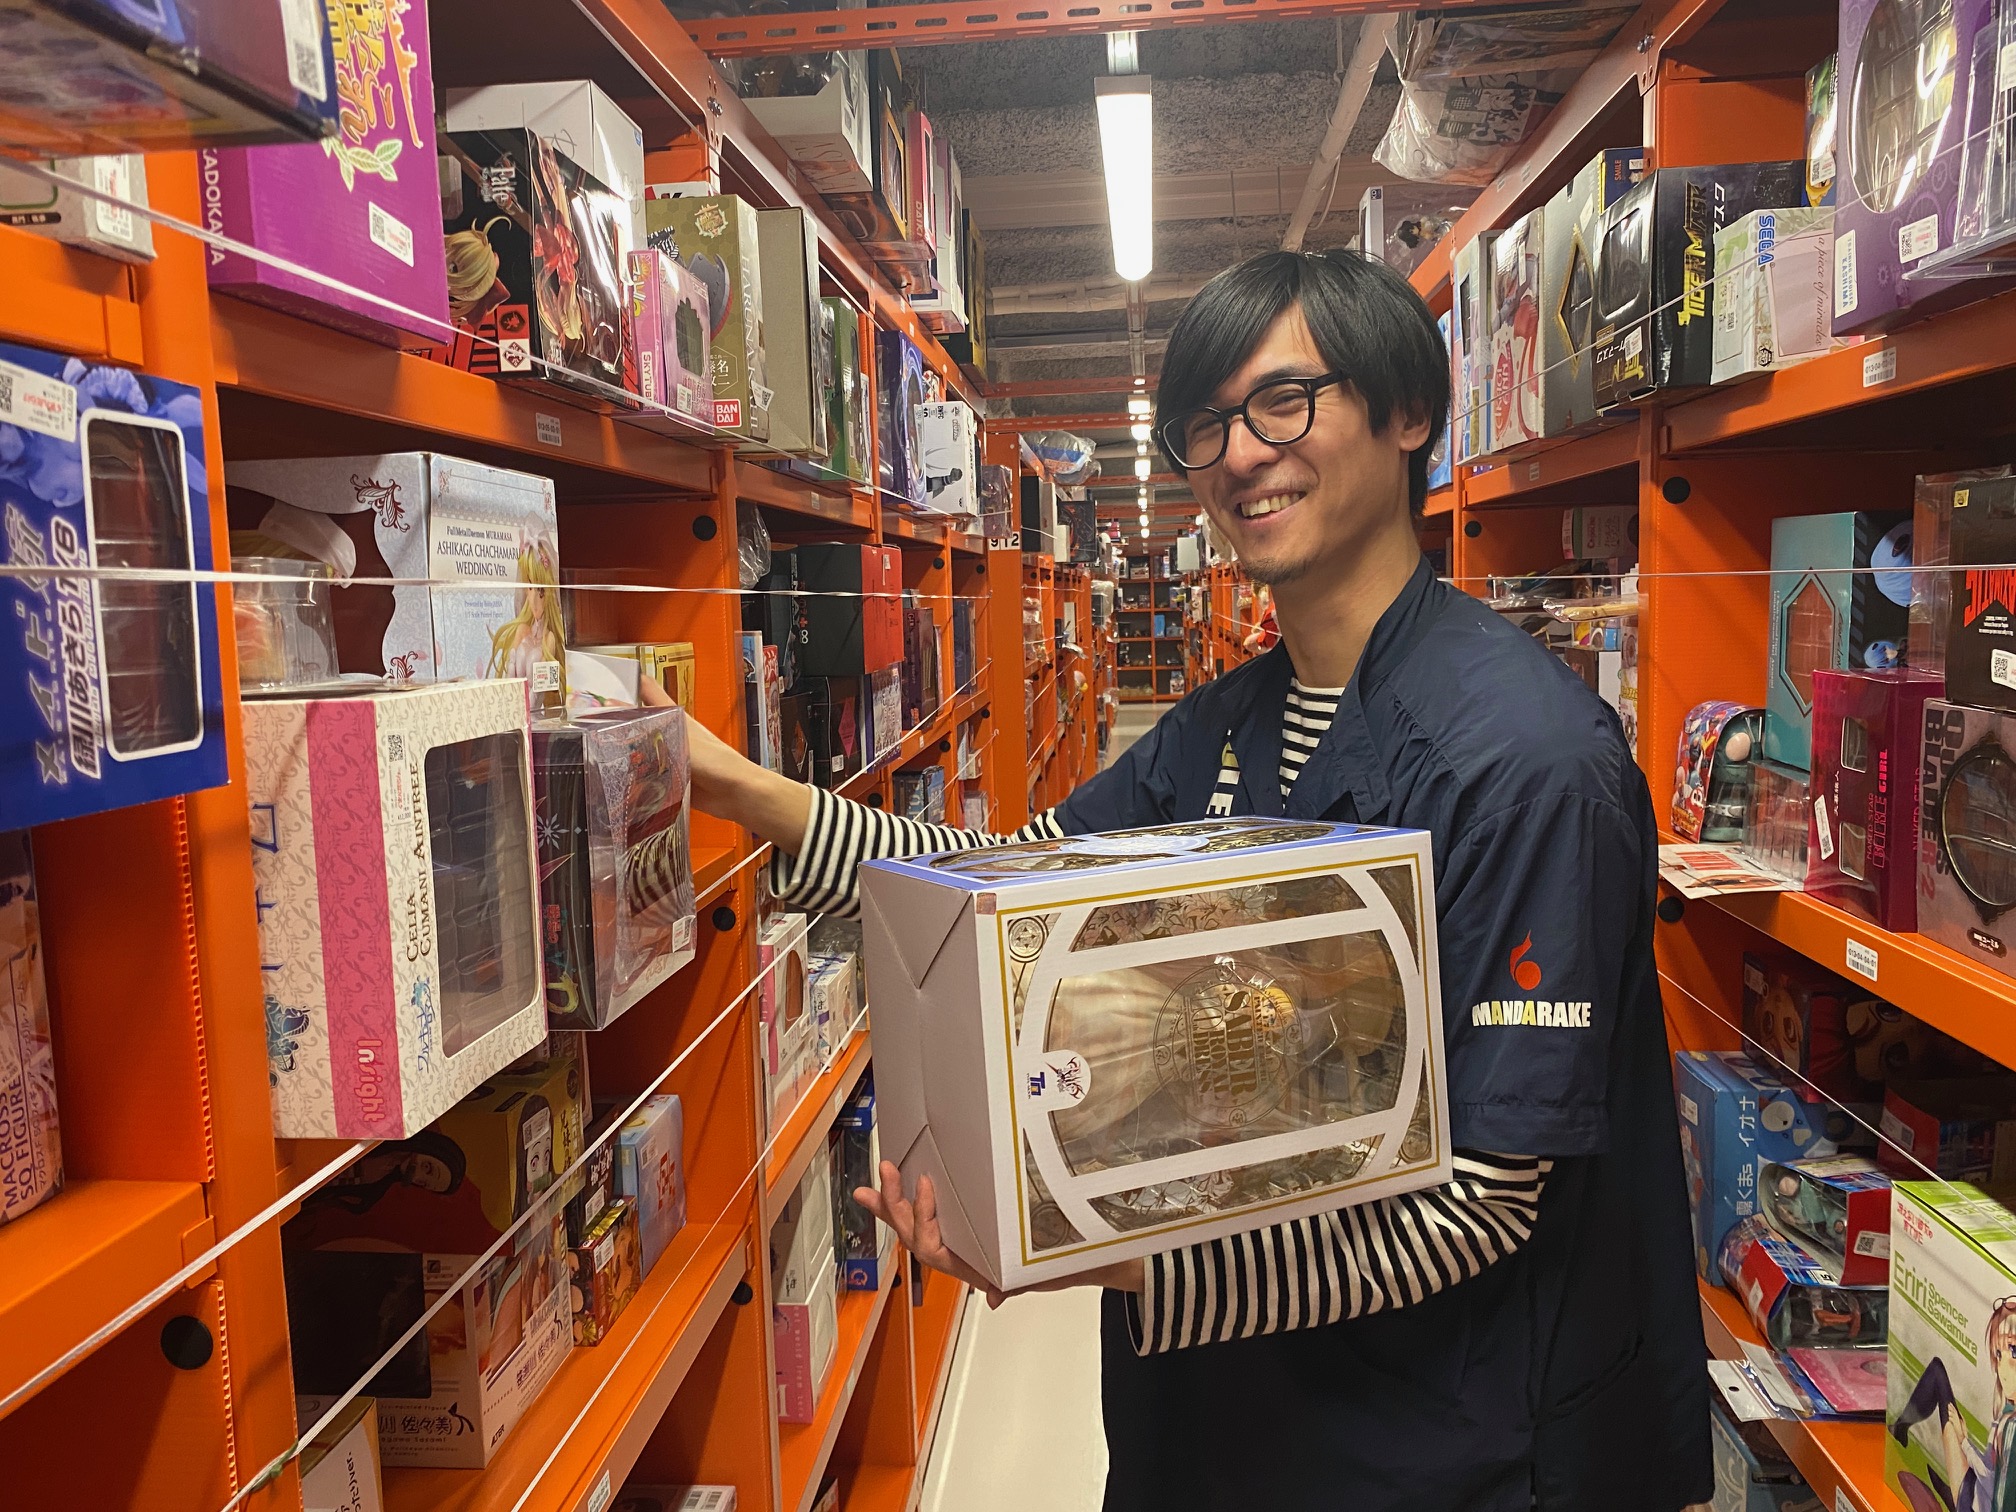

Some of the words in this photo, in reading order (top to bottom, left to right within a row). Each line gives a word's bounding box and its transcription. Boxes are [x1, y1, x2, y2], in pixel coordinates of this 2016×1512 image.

[1758, 214, 1776, 266] SEGA
[1816, 248, 1825, 273] piece
[1815, 276, 1825, 290] of
[1841, 257, 1849, 308] KASHIMA
[742, 256, 755, 361] HARUNA
[1815, 292, 1825, 348] miracles
[716, 404, 738, 413] BAN
[717, 413, 734, 423] DAI
[437, 541, 474, 557] ASHIKAGA
[474, 544, 520, 560] CHACHAMARU
[456, 561, 493, 576] WEDDING
[1878, 748, 1888, 793] GIRL
[409, 761, 427, 861] AINTREE
[406, 890, 419, 963] CELIA
[1471, 999, 1592, 1028] MANDARAKE
[1208, 1030, 1230, 1100] ROYAL
[1223, 991, 1257, 1097] SABER
[356, 1037, 386, 1123] Insight
[8, 1075, 29, 1161] FIGURE
[1738, 1095, 1756, 1148] イオナ
[18, 1163, 35, 1200] SQ
[1893, 1249, 1928, 1309] Eriri
[1927, 1301, 1978, 1356] Sawamura
[1928, 1283, 1969, 1330] Spencer
[401, 1415, 452, 1435] 佐々美
